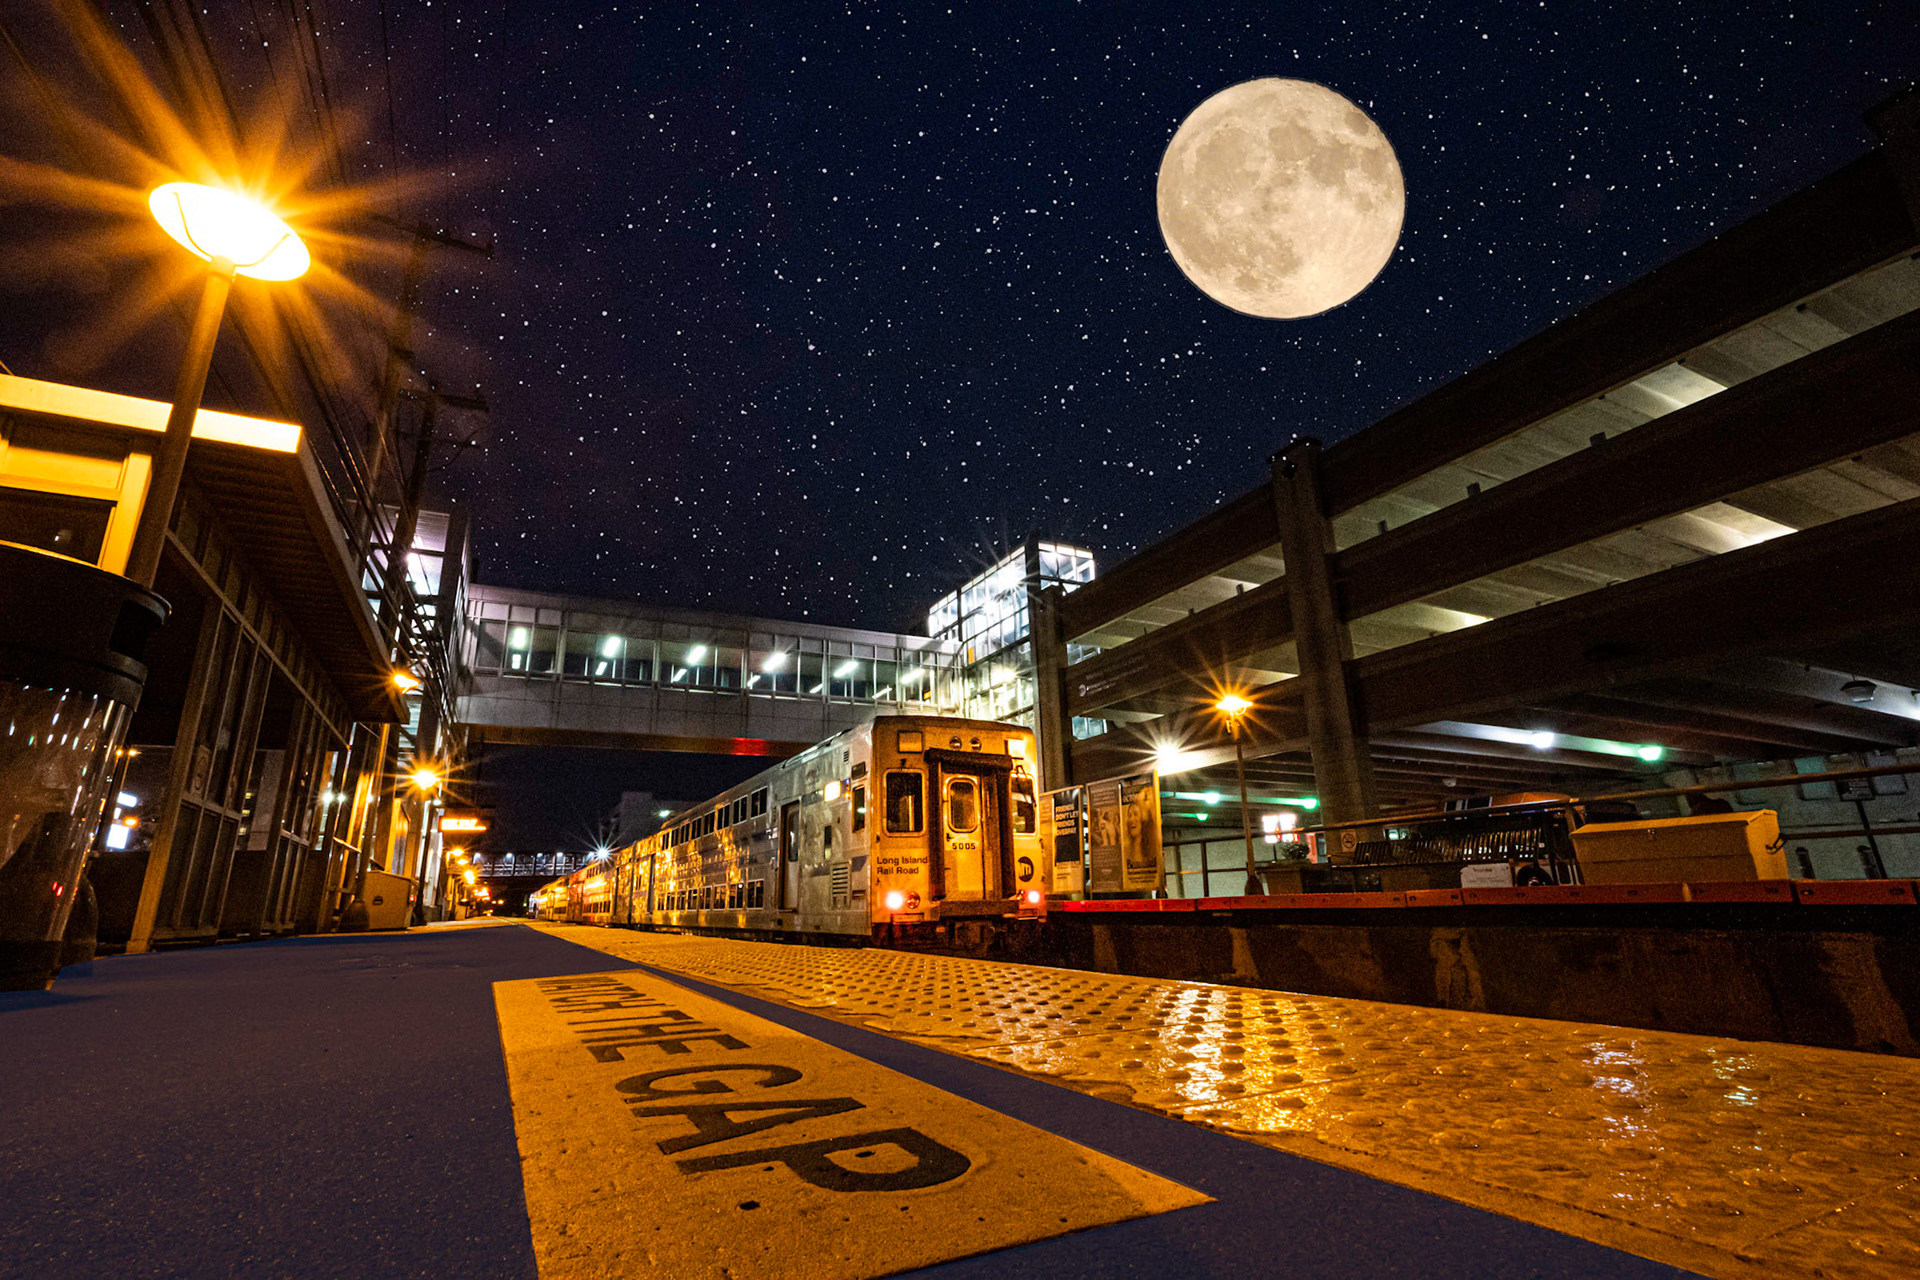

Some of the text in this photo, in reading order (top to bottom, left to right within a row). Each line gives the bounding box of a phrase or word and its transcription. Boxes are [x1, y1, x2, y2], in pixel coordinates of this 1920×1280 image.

[951, 842, 976, 850] 5005
[876, 855, 928, 866] Long Island
[876, 865, 920, 875] Rail Road
[535, 976, 972, 1193] WATCH THE GAP
